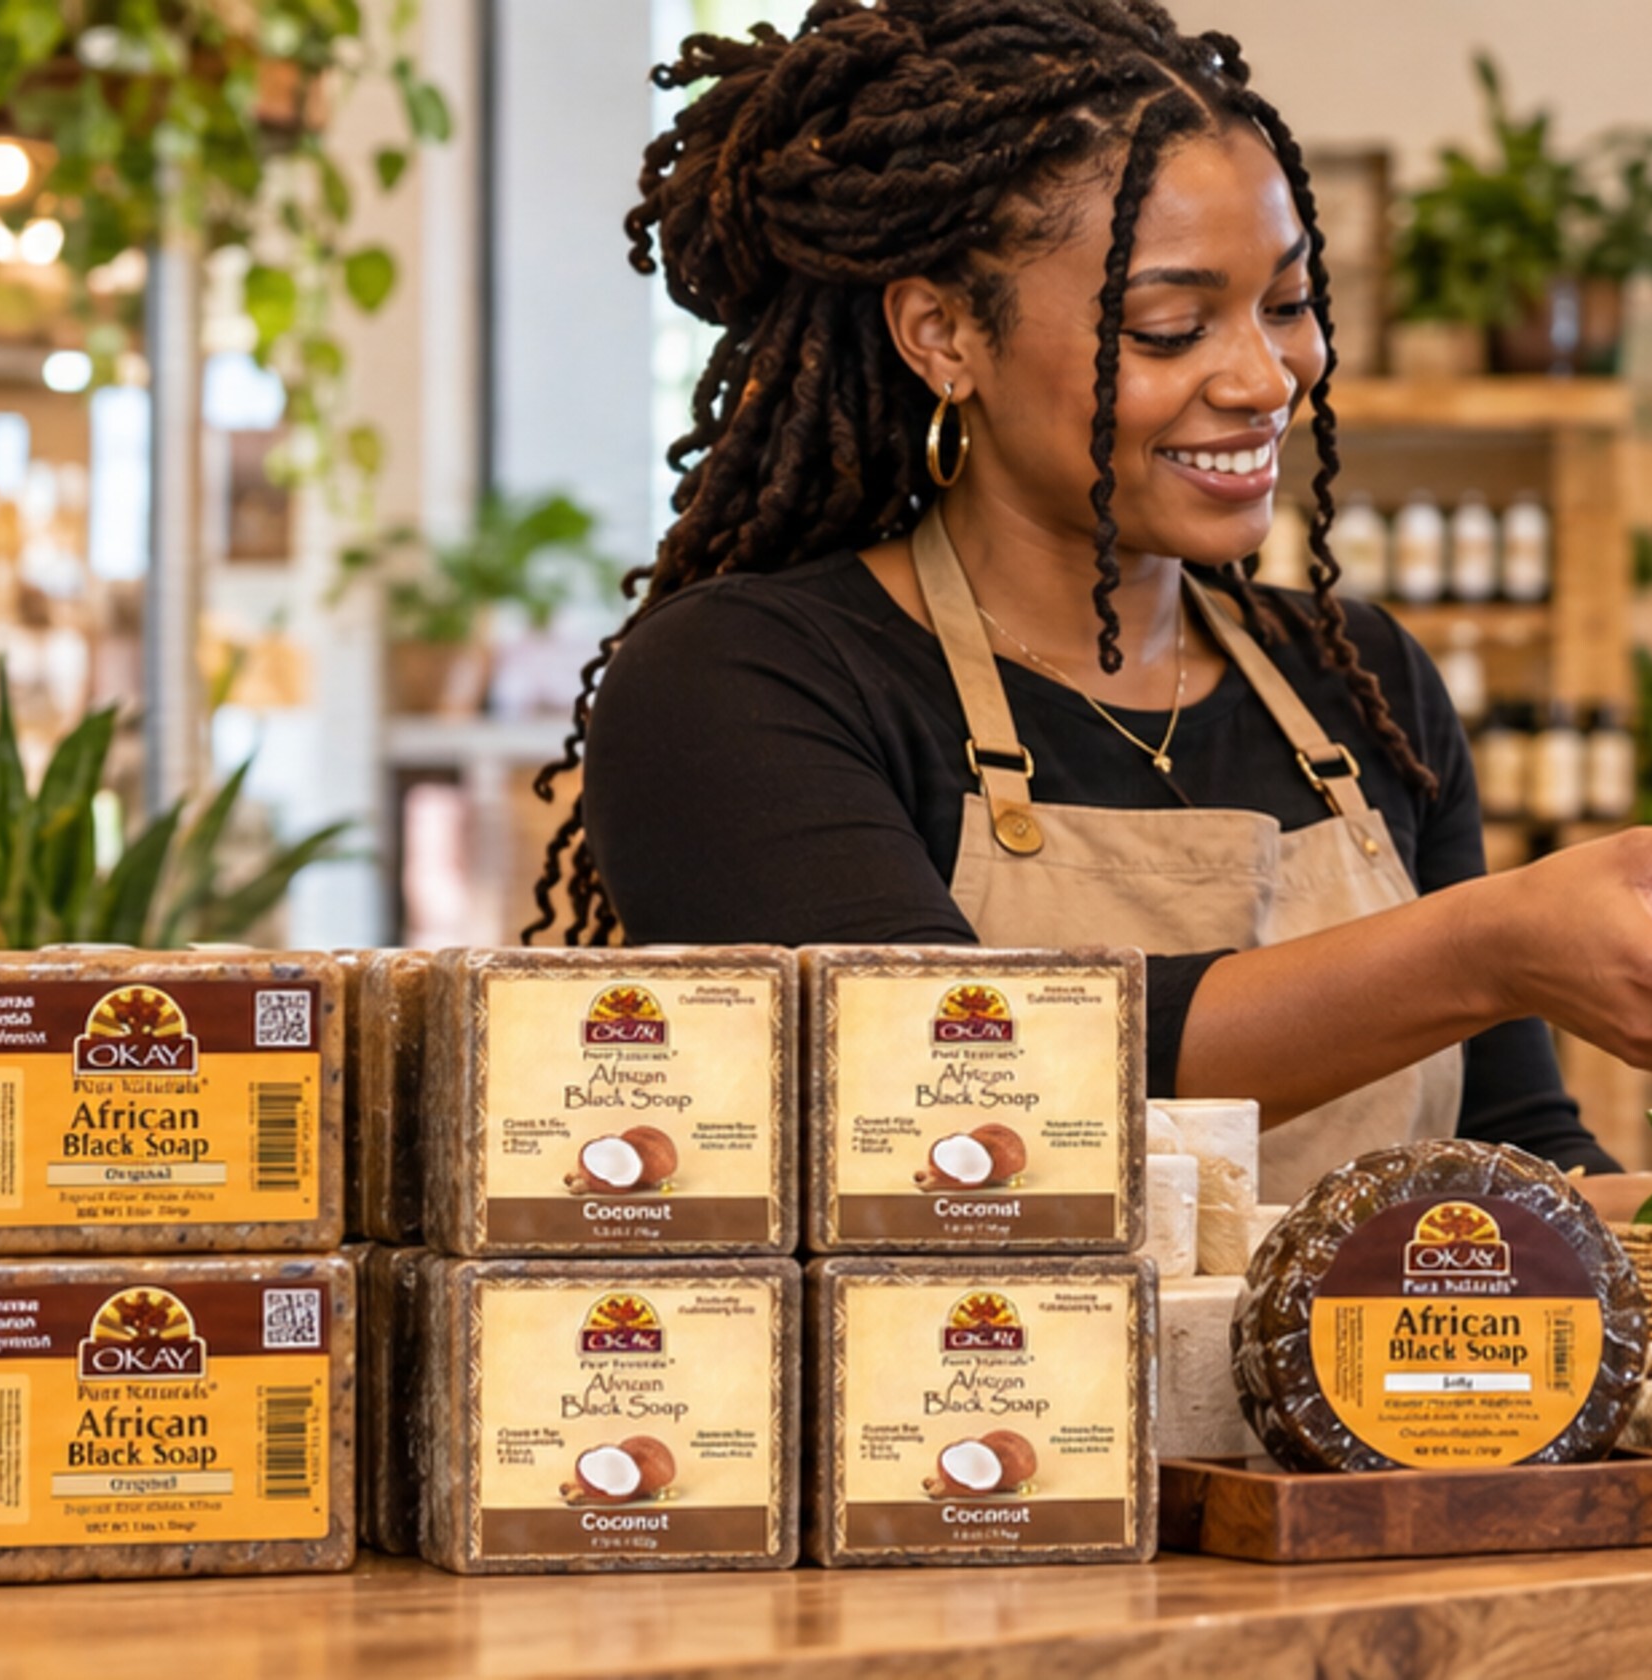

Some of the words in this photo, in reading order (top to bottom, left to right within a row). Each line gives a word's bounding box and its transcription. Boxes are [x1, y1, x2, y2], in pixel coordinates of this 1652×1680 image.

[87, 1043, 185, 1067] OKAY
[915, 1084, 973, 1108] Black
[71, 1099, 199, 1131] African
[63, 1132, 133, 1158] Black
[145, 1133, 210, 1163] Soap
[583, 1202, 672, 1221] Coconut
[1394, 1305, 1521, 1336] African
[92, 1347, 193, 1372] OKAY
[1389, 1338, 1456, 1362] Black
[1466, 1341, 1528, 1366] Soap
[561, 1394, 621, 1419] Black
[626, 1396, 689, 1422] Soap
[77, 1406, 208, 1439] African
[68, 1440, 144, 1468] Black
[153, 1441, 217, 1471] Soap
[581, 1513, 669, 1531] Coconut
